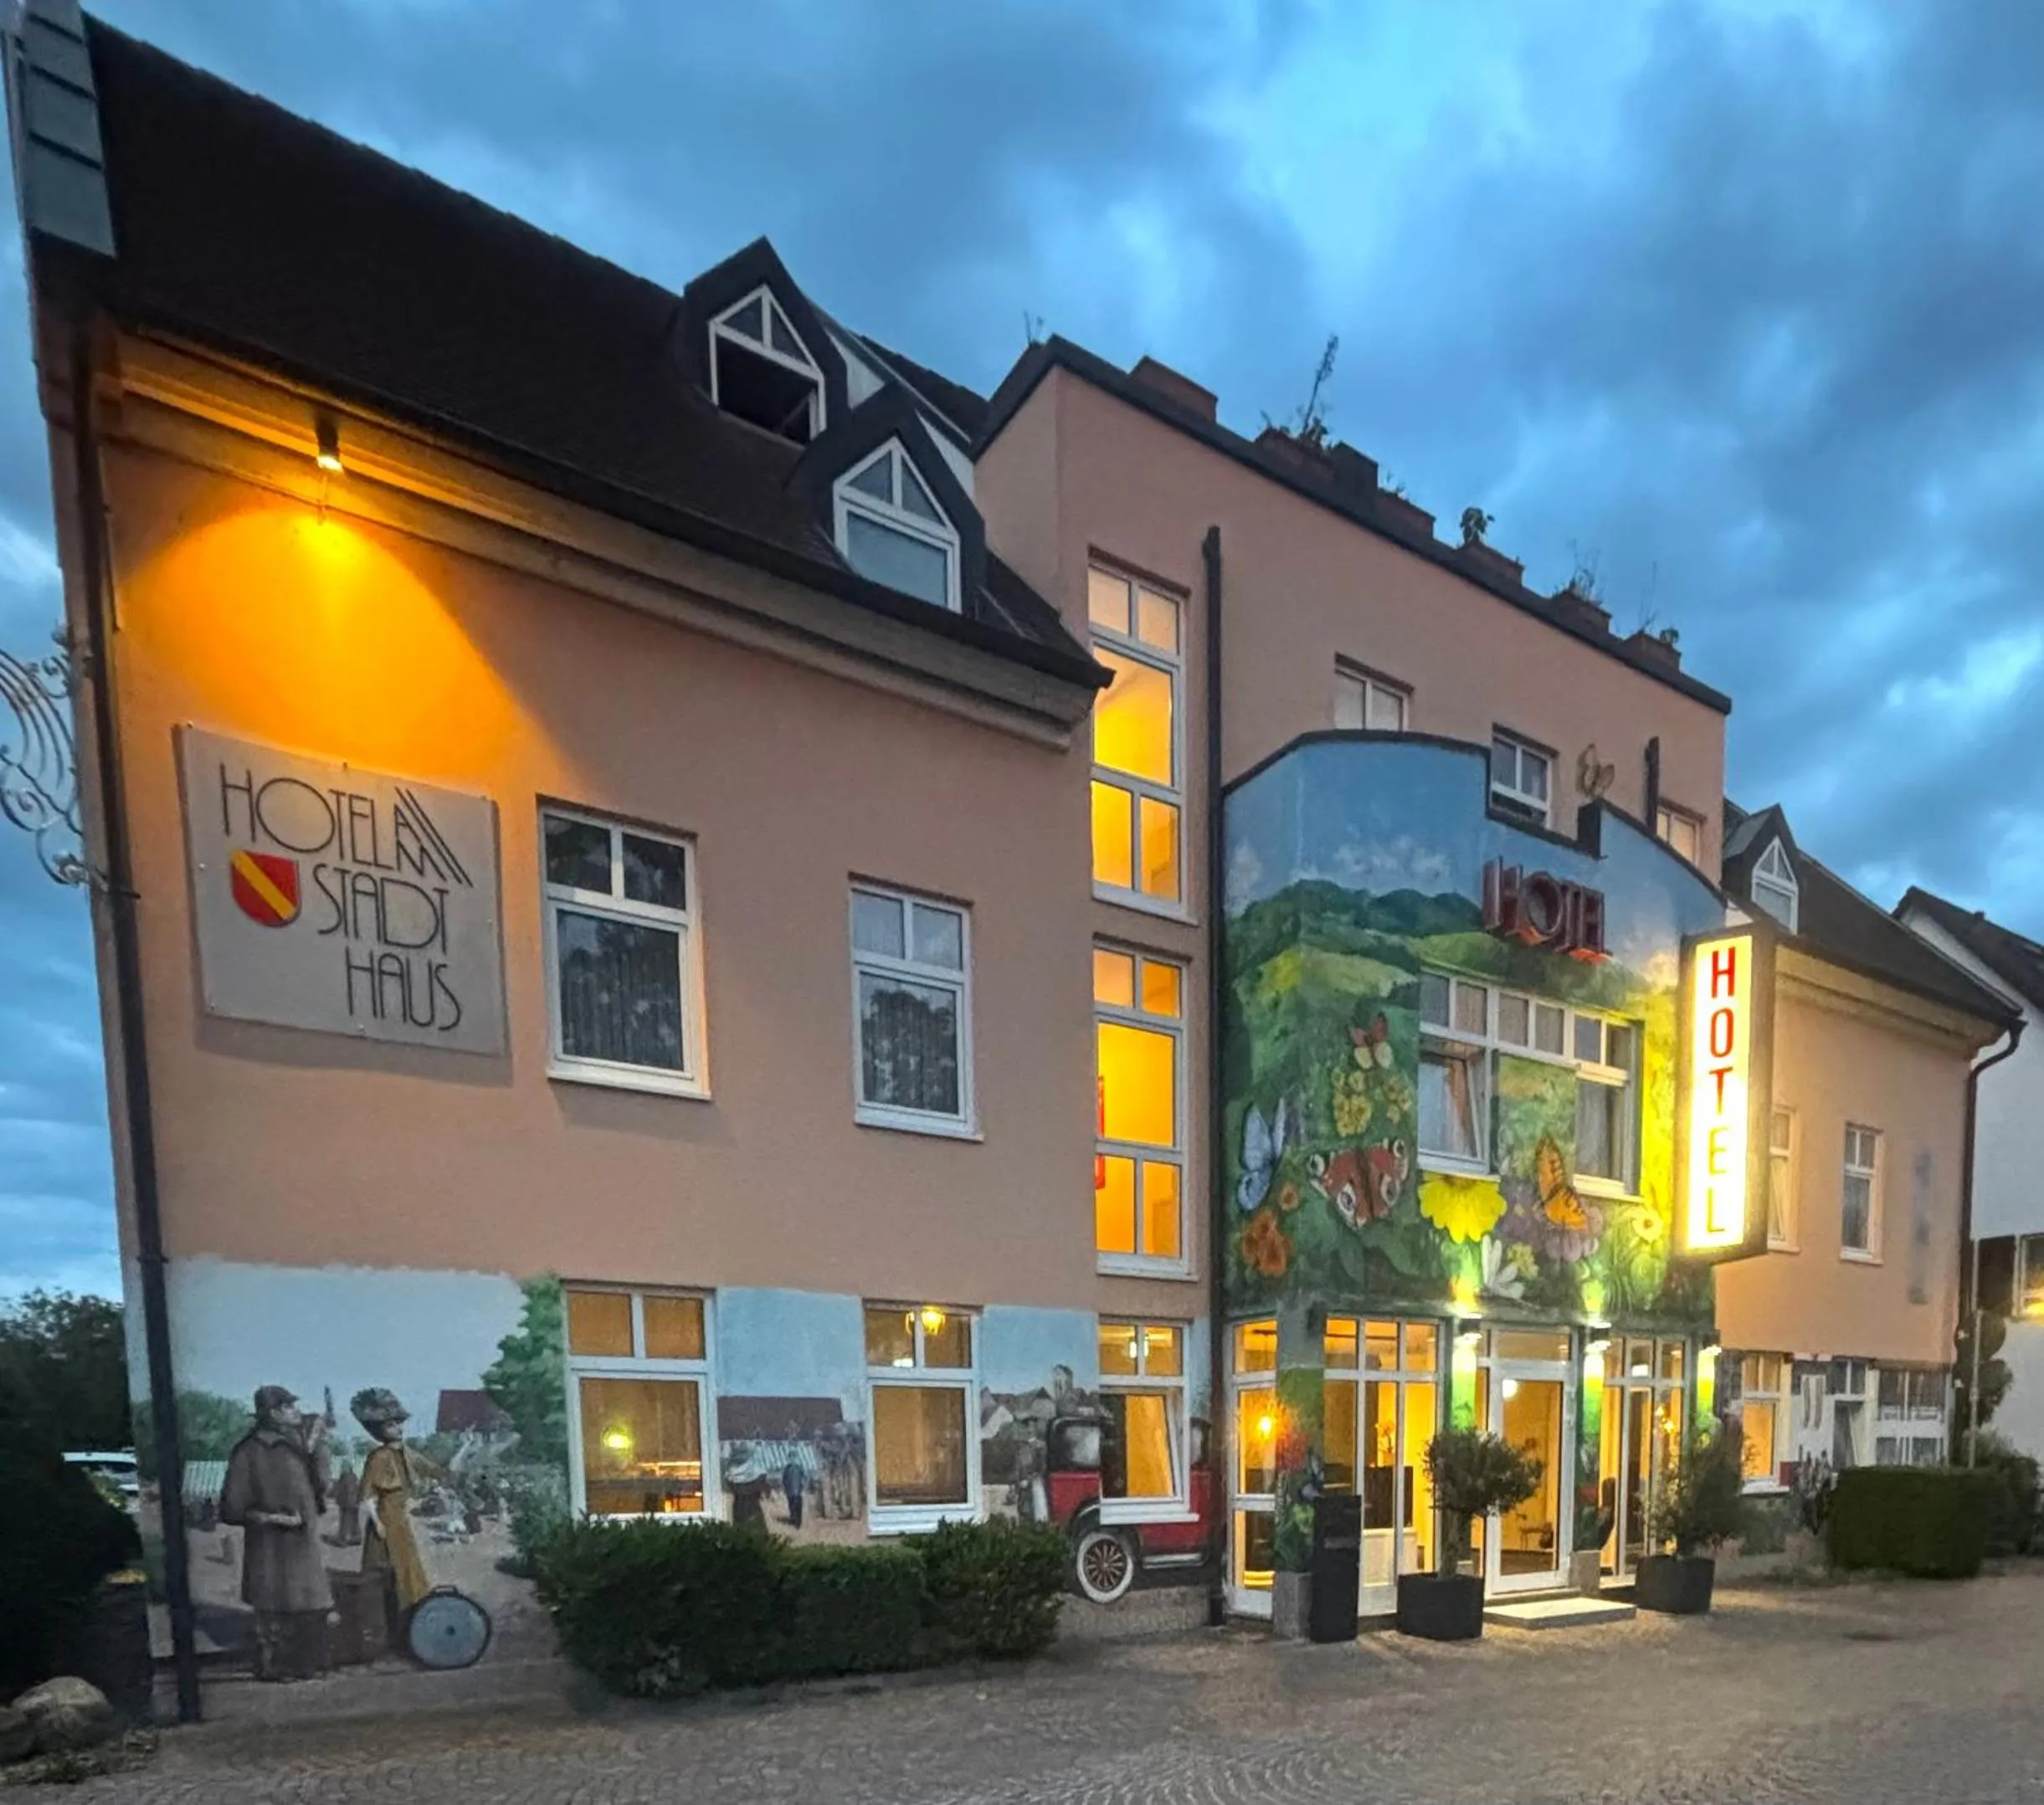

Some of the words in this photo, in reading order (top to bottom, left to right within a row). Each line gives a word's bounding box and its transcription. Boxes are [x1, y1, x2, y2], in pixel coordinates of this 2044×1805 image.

[220, 762, 393, 870] HOTEL
[393, 790, 465, 885] AM
[313, 863, 449, 955] STADT
[345, 946, 462, 1031] HAUS
[1706, 946, 1736, 1233] HOTEL
